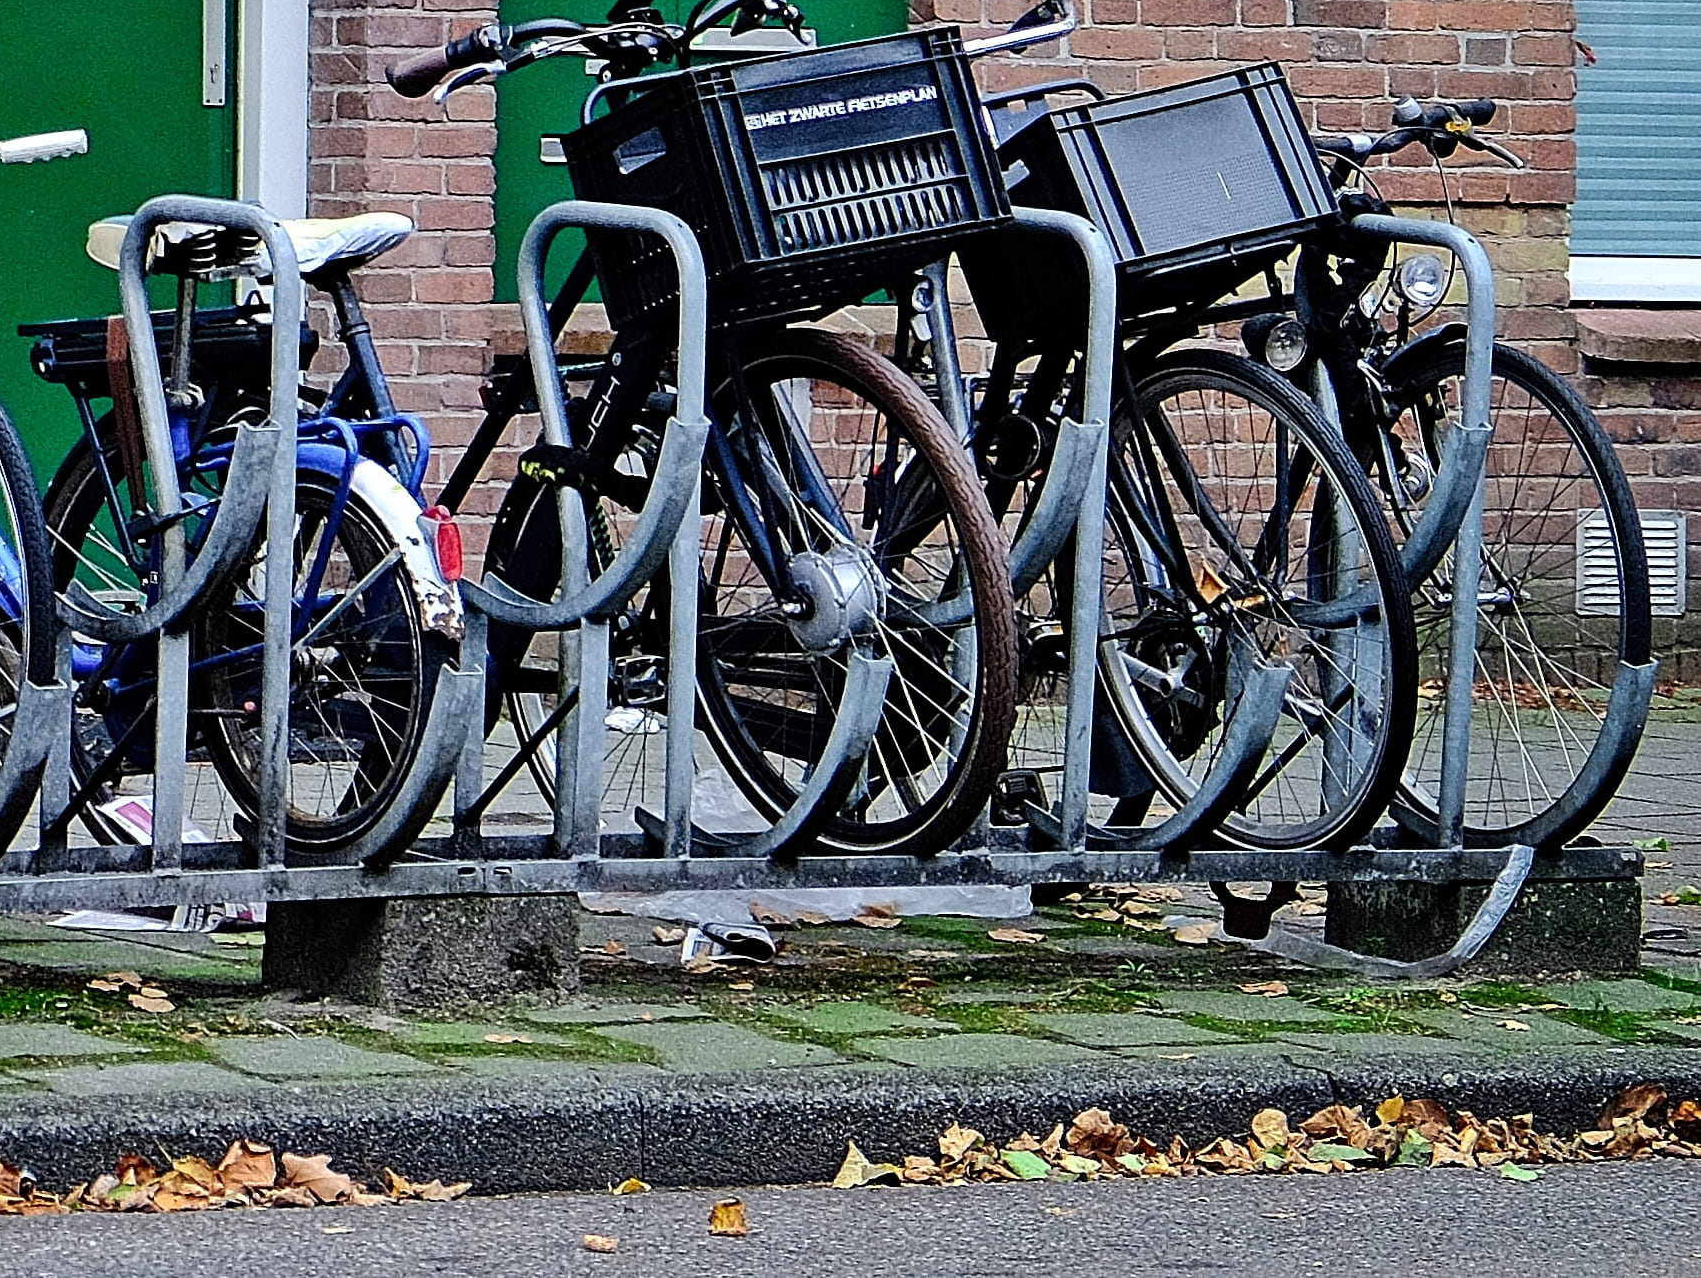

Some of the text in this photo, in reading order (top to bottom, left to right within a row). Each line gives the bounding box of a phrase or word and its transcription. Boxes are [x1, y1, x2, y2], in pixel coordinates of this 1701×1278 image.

[761, 86, 938, 127] HET ZWARTE FIETSENPLAN
